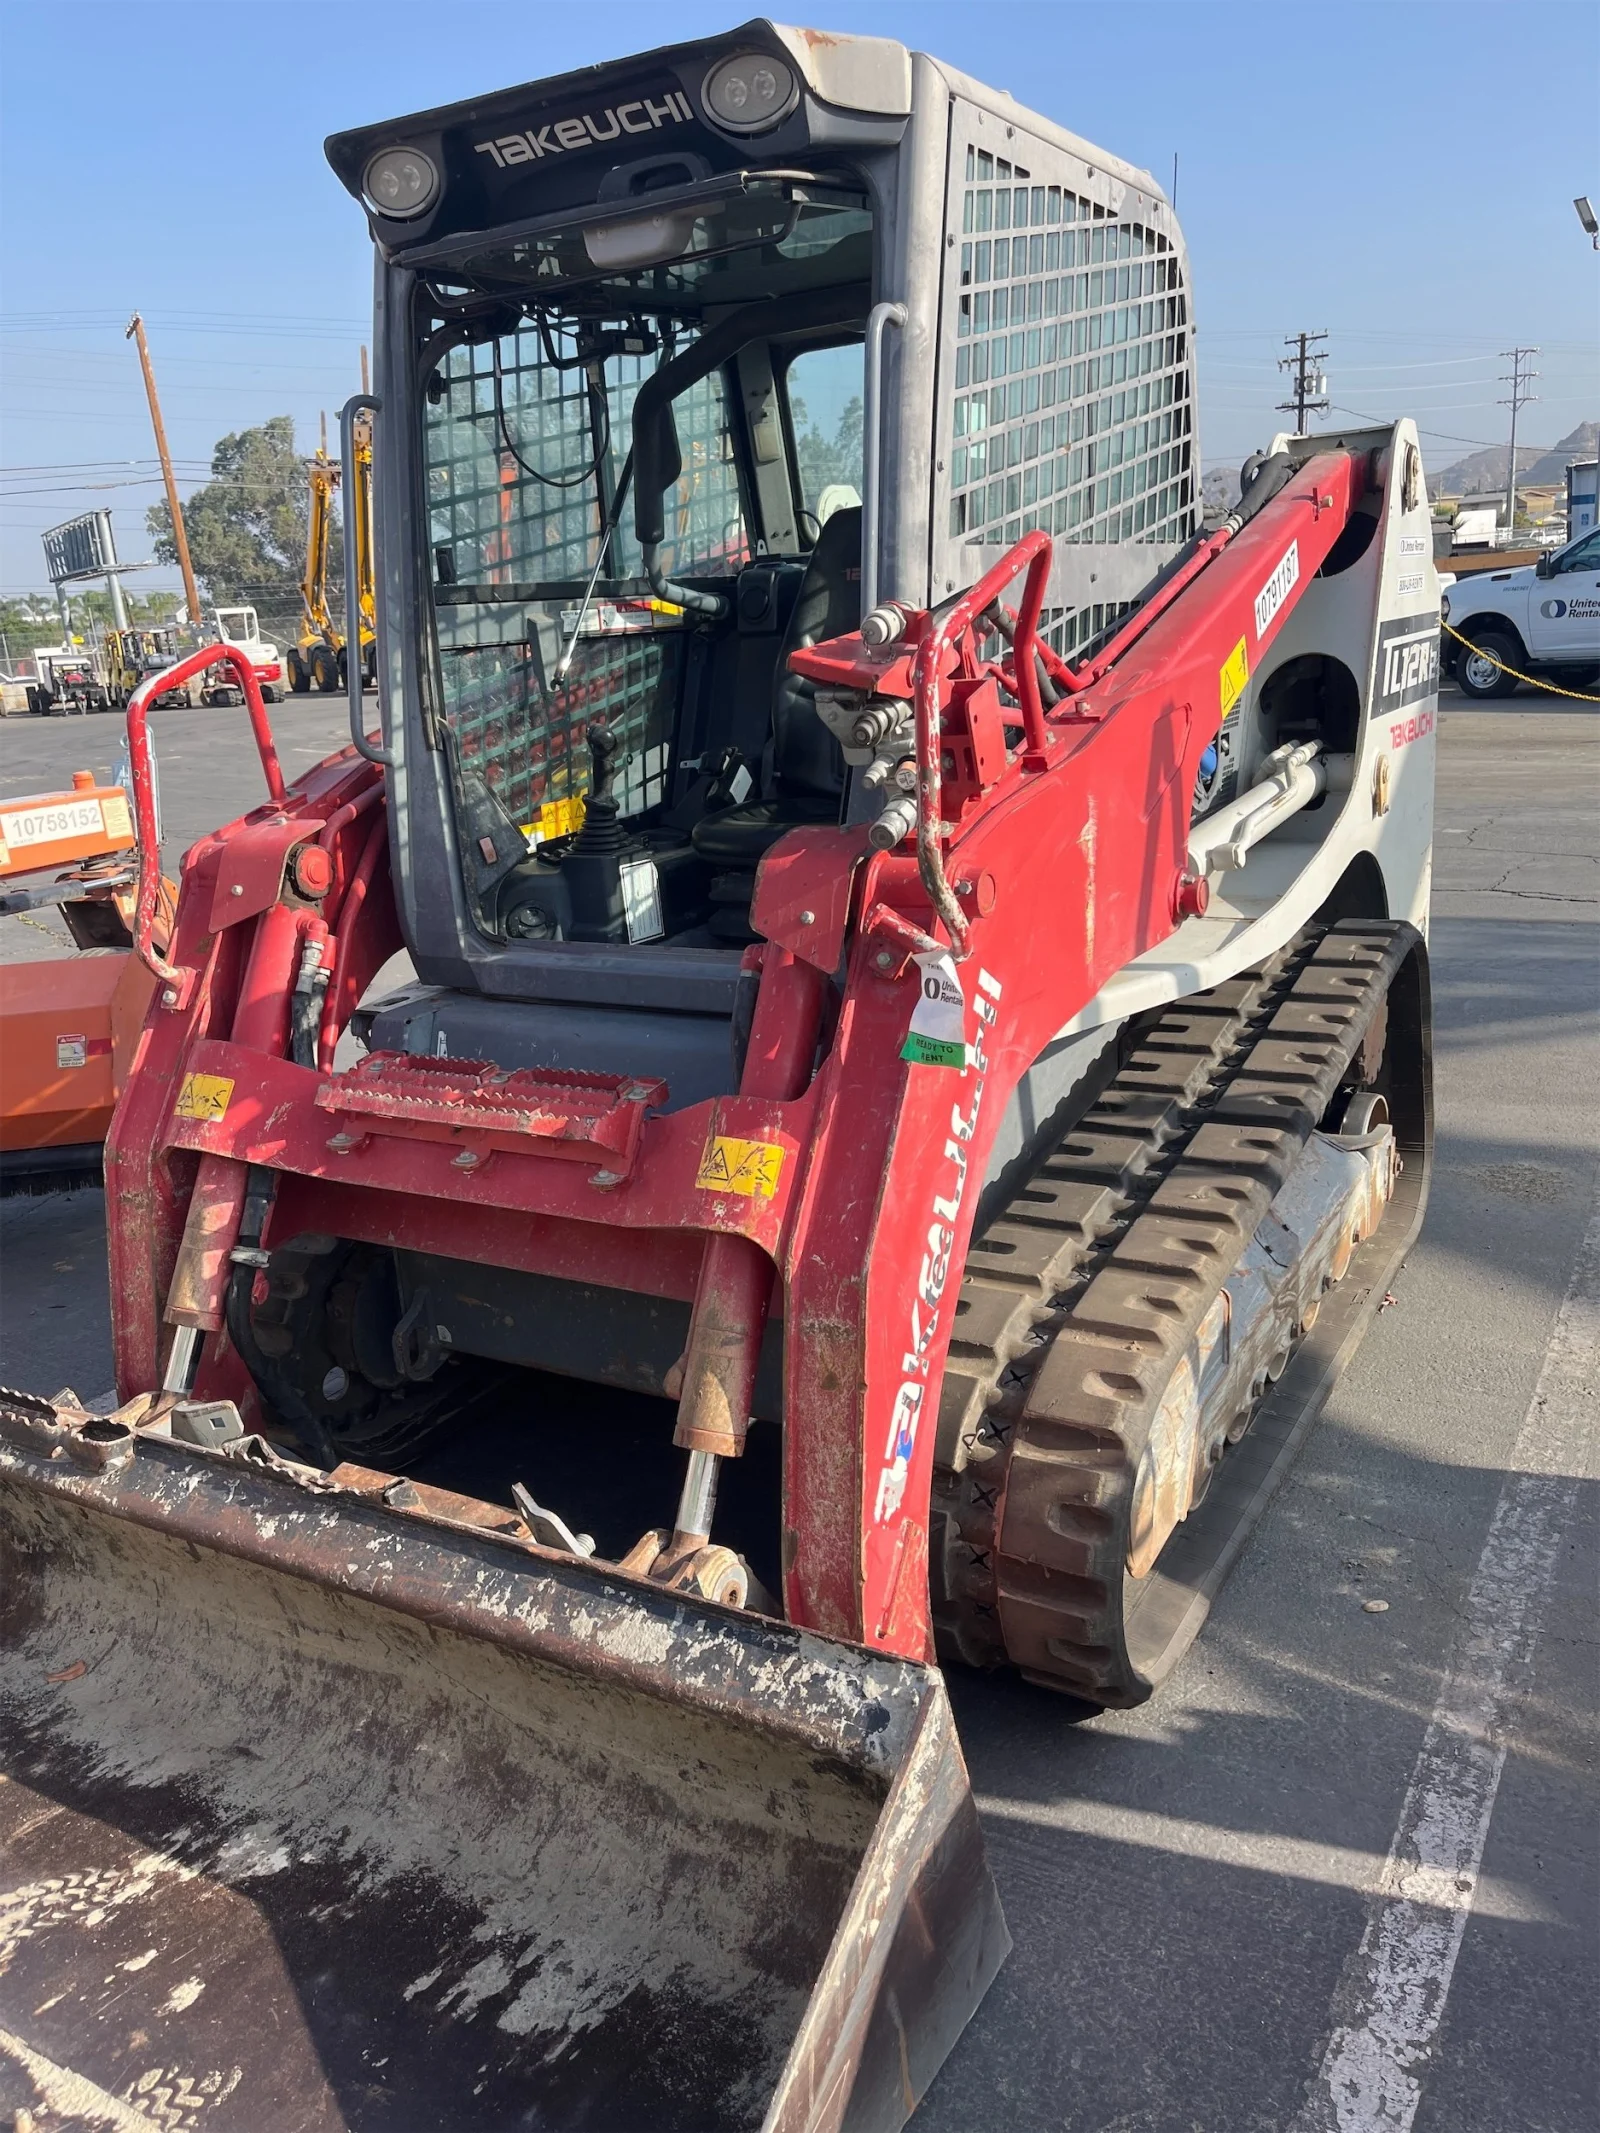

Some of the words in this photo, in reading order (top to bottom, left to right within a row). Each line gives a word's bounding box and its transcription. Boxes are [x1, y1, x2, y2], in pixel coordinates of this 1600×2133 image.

[474, 91, 694, 168] TAKEUCHI
[1257, 548, 1295, 630] 10791187
[1568, 609, 1600, 618] Renta
[1390, 711, 1434, 750] TAKEUCHI
[13, 806, 100, 837] 10758152
[941, 980, 960, 994] Unit
[940, 992, 963, 1007] Rentals
[915, 1038, 937, 1052] READY
[940, 1045, 954, 1054] TO
[921, 1052, 943, 1063] RENT
